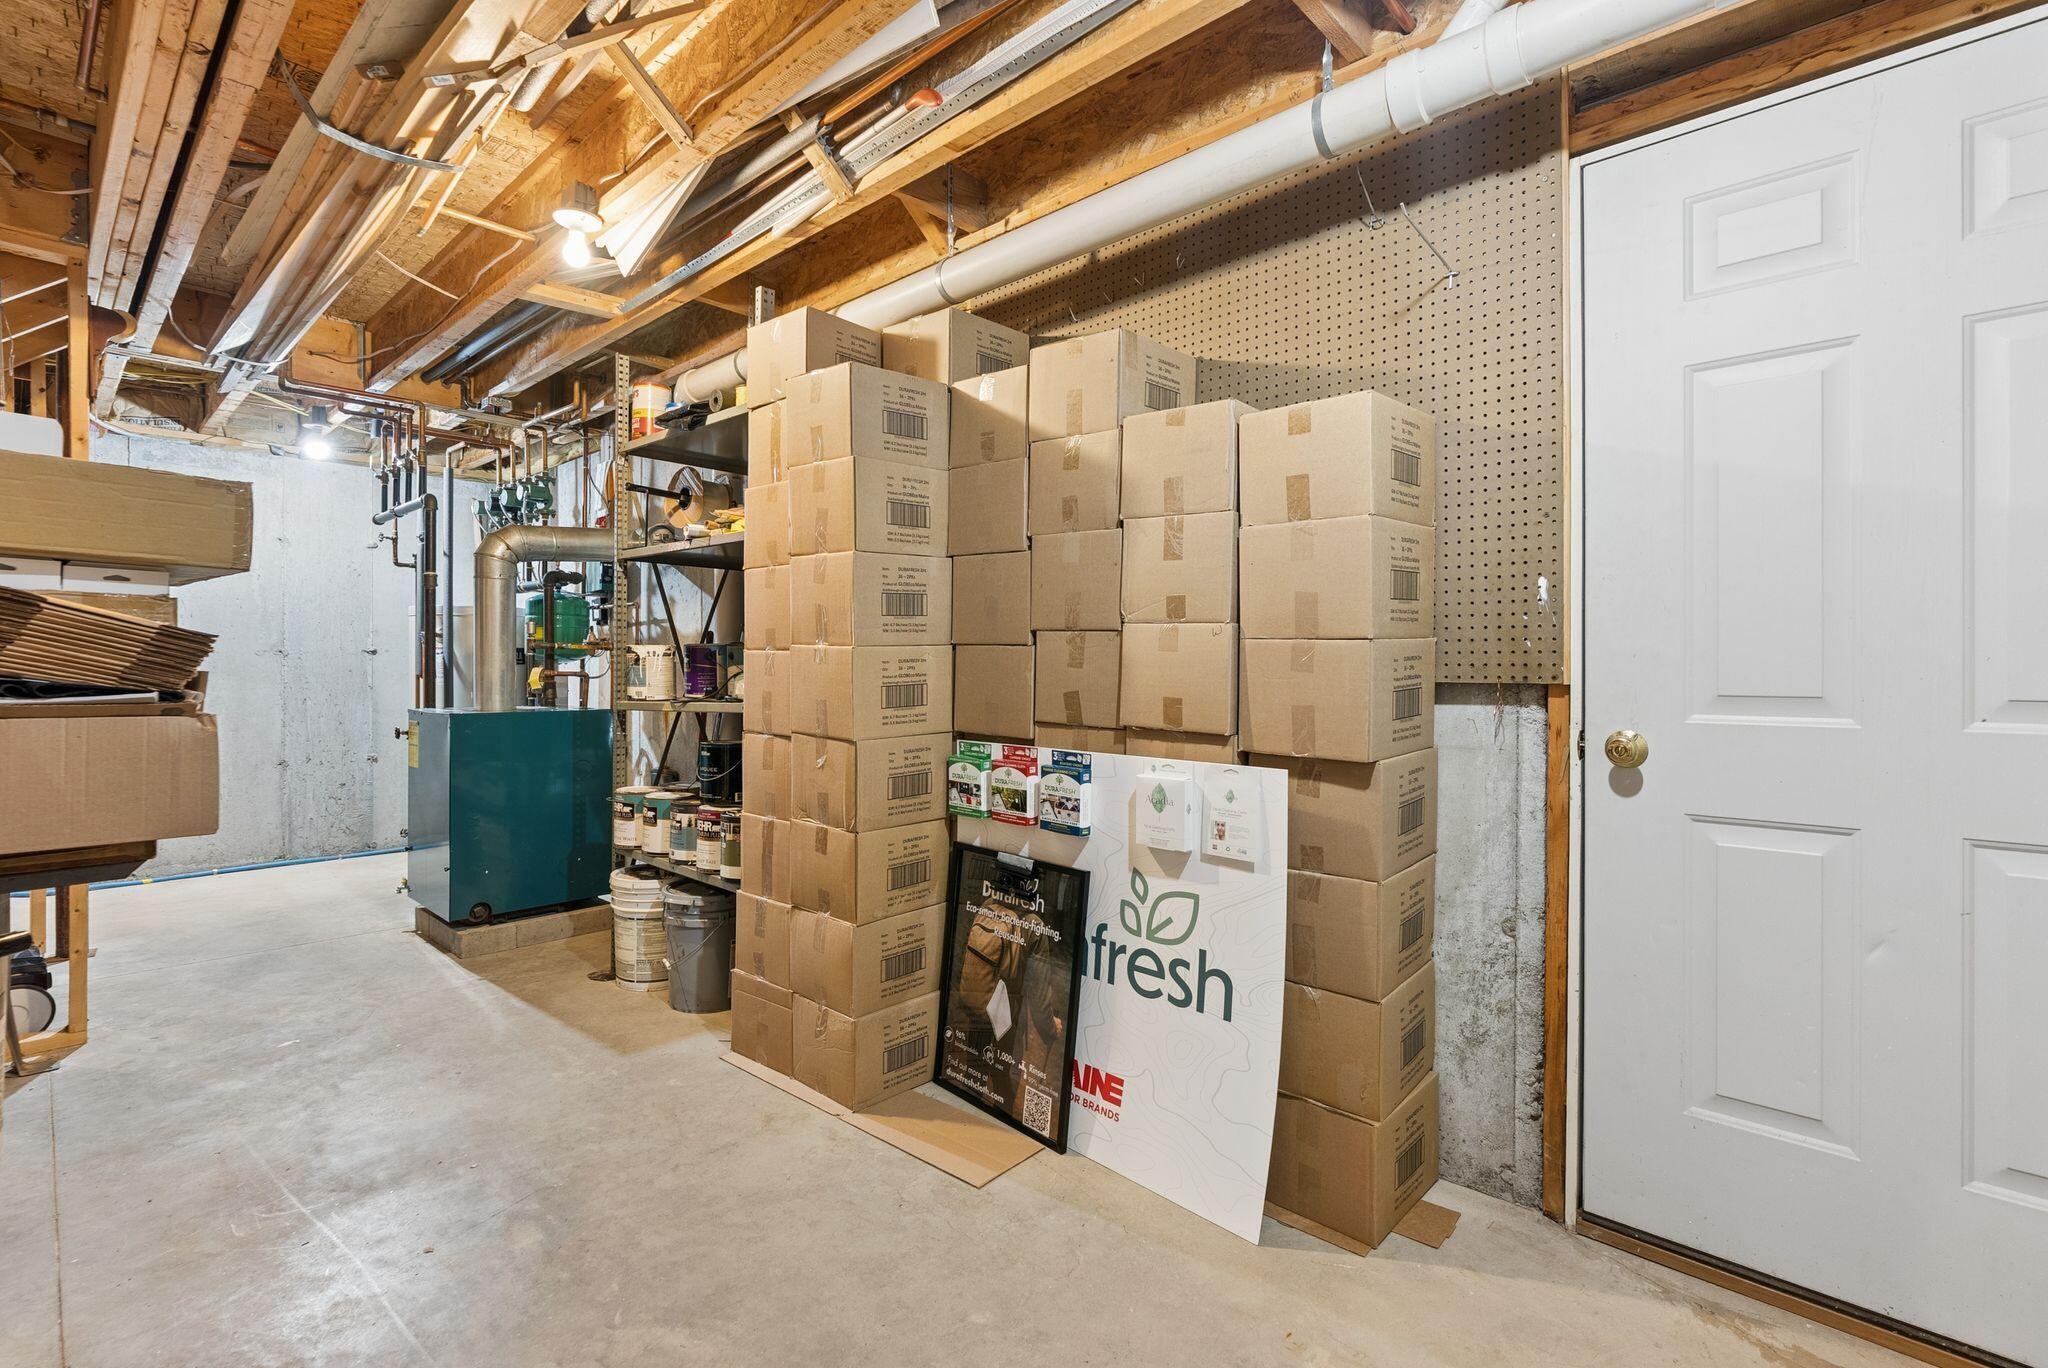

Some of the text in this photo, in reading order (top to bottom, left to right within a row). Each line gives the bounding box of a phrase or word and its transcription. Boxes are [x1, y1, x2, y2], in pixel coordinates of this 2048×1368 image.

[1053, 752, 1058, 760] 3
[995, 778, 1022, 787] DURAFRESH
[1045, 784, 1076, 795] DURAFRESH
[1145, 793, 1174, 806] Acadia
[994, 927, 1026, 946] Reusable.
[1081, 922, 1233, 1022] fresh
[997, 1050, 1016, 1064] 1,000+
[948, 1055, 958, 1066] Find
[959, 1063, 967, 1071] out
[968, 1068, 981, 1078] more
[946, 1068, 1004, 1104] durafreshcloth.com
[1082, 1097, 1120, 1122] BRANDS
